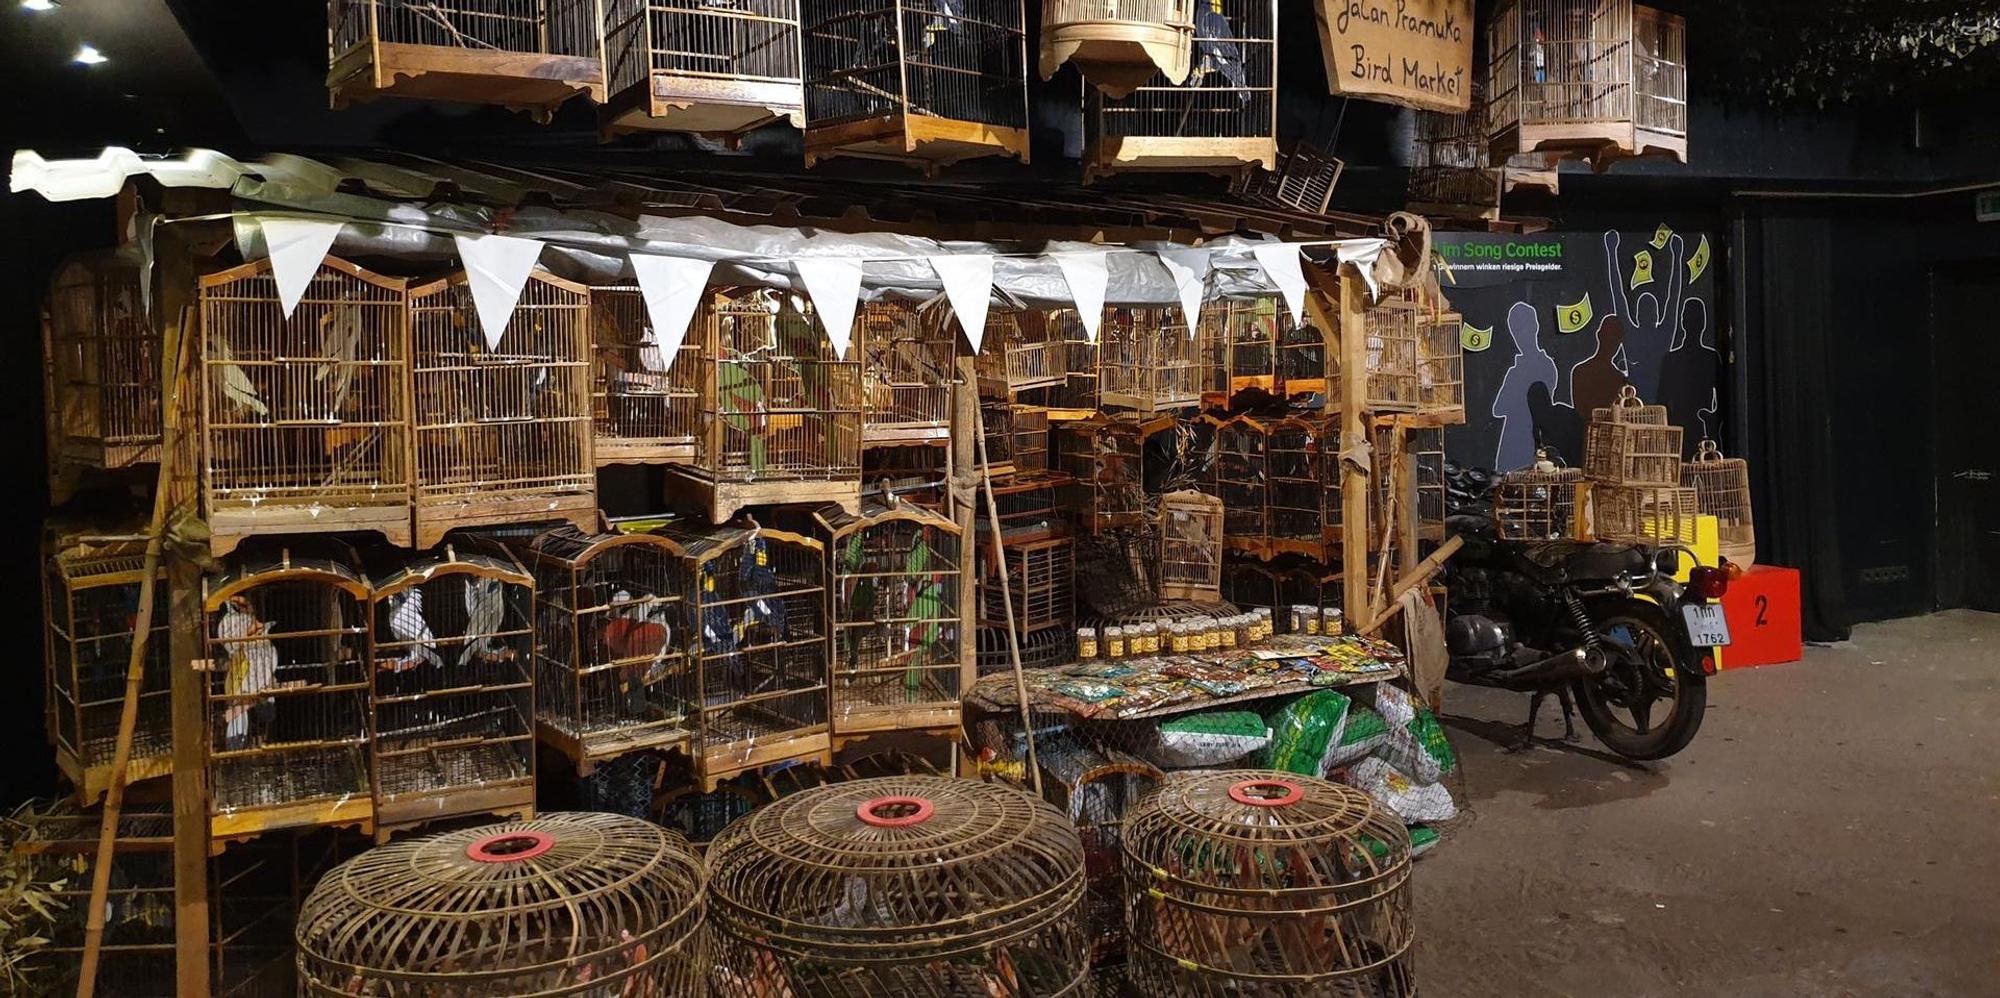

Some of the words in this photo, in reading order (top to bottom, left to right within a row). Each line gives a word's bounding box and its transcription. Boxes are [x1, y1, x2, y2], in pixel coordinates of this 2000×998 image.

[1337, 0, 1390, 34] Jalan
[1351, 44, 1392, 84] Bird
[1403, 57, 1463, 96] Market
[1464, 242, 1502, 260] Song
[1506, 242, 1562, 257] Contest
[1475, 263, 1501, 271] winken
[1502, 263, 1524, 272] riesige
[1754, 594, 1768, 627] 2
[1697, 633, 1725, 644] 1762
